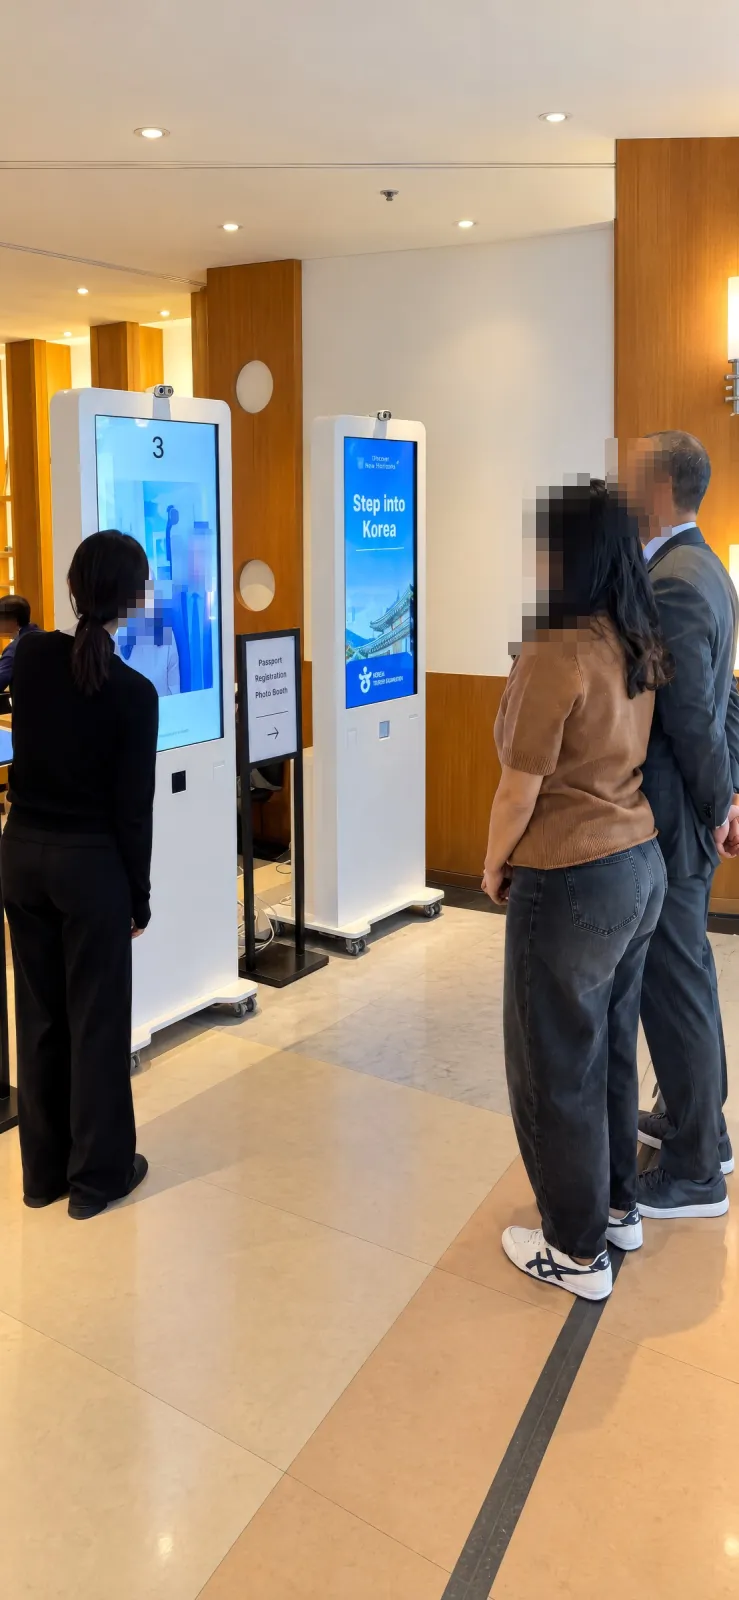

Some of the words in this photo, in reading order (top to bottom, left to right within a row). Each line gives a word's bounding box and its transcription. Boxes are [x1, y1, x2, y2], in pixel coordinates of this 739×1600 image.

[153, 436, 164, 459] 3
[353, 494, 381, 516] Step
[384, 494, 406, 512] into
[363, 520, 396, 538] Korea
[258, 657, 282, 666] Passport
[255, 672, 287, 682] Registration
[255, 690, 271, 699] Photo
[272, 687, 288, 696] Booth
